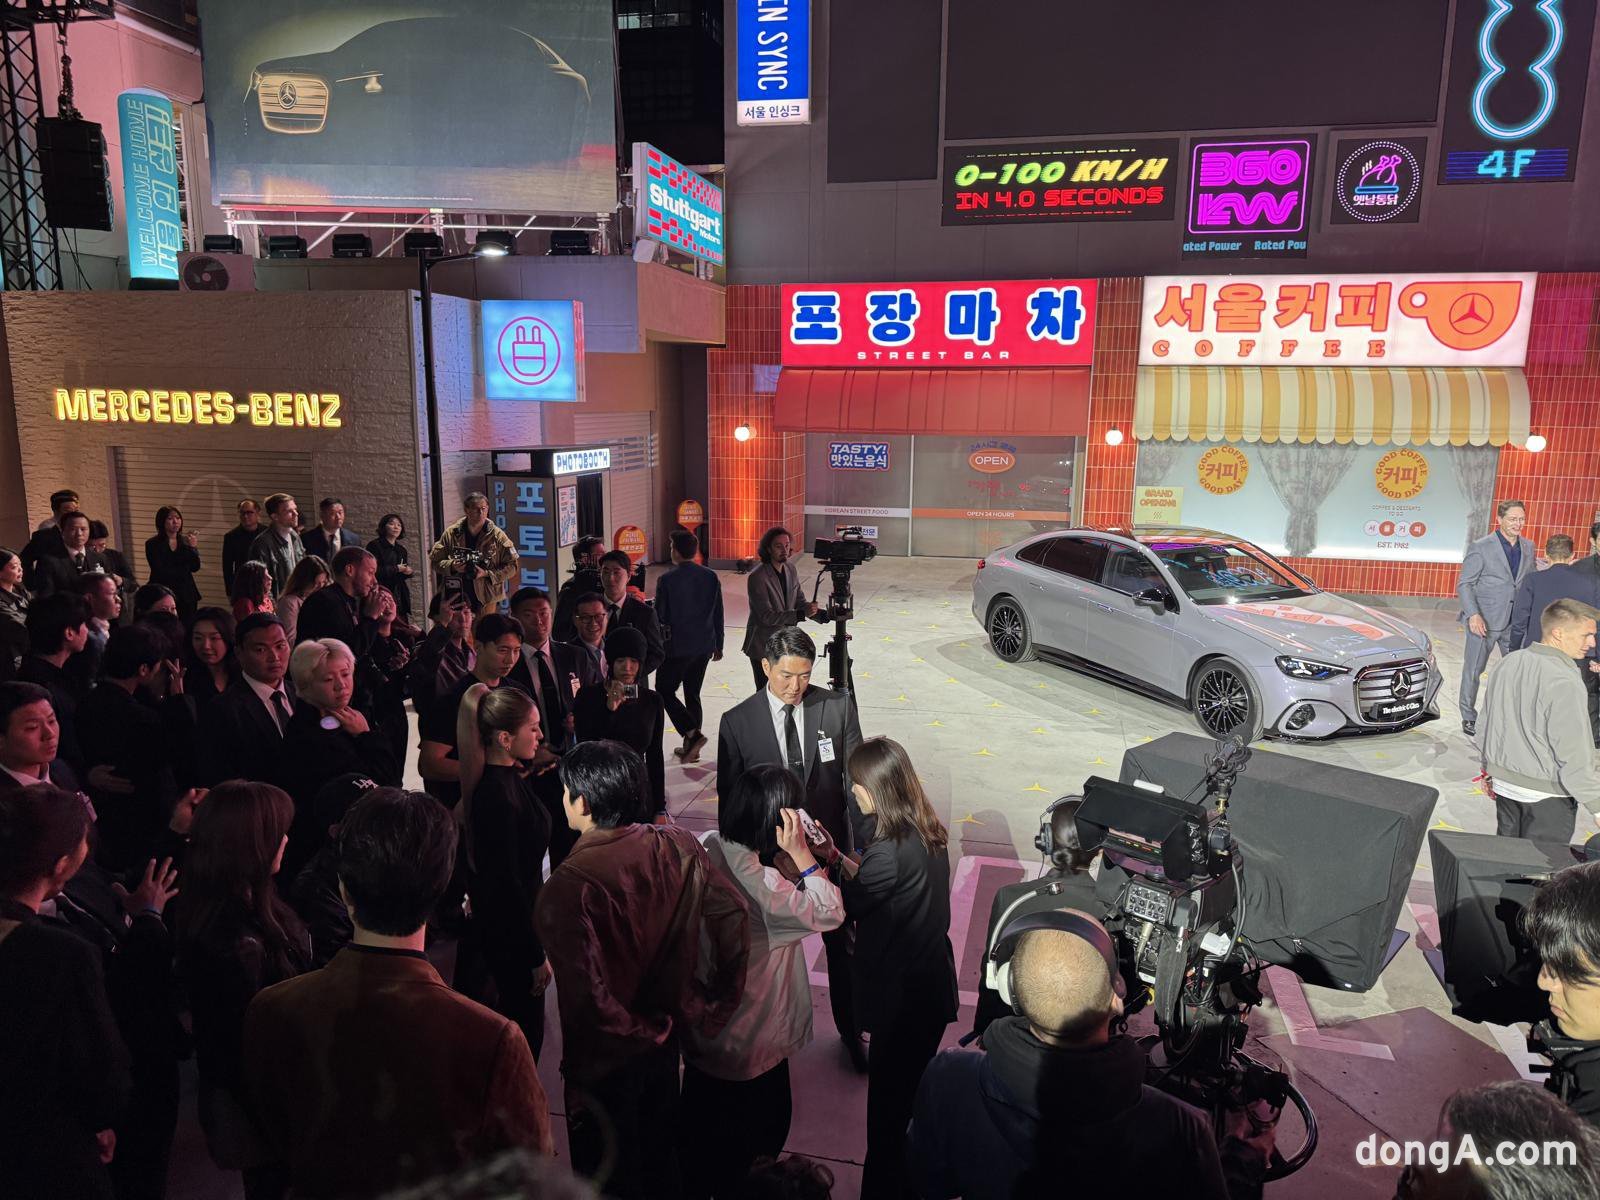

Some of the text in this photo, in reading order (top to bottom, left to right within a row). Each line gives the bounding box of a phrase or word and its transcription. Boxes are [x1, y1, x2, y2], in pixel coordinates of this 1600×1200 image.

[757, 31, 788, 90] SYNC
[745, 105, 800, 119] 서울 인싱크
[954, 158, 1169, 187] 0-100 KM/H
[1477, 149, 1536, 178] 4F
[127, 99, 158, 266] WELCOME HOME
[955, 186, 1165, 210] IN 4.0 SECONDS
[649, 183, 721, 236] Stuttgart
[155, 219, 181, 276] 서울
[1208, 241, 1243, 252] Power
[1254, 240, 1285, 251] Rated
[790, 286, 1086, 347] 포장마차
[1154, 281, 1393, 333] 서울커피
[857, 351, 1011, 360] STREET BAR
[1152, 340, 1386, 357] COFFEE
[55, 388, 342, 428] MERCEDES-BENZ
[831, 443, 887, 454] TASTY!
[1198, 446, 1248, 472] GOOD COFFEE
[556, 451, 608, 472] PHOTOBOOTH
[831, 455, 887, 468] 맛있는음식
[974, 456, 1009, 465] OPEN
[1376, 448, 1428, 476] GOOD COFFEE
[1205, 462, 1239, 481] 커피
[1382, 466, 1418, 485] 커피
[1199, 477, 1224, 494] GOOD
[1377, 482, 1423, 499] GOOD DAY
[1377, 541, 1409, 549] EST. 1982
